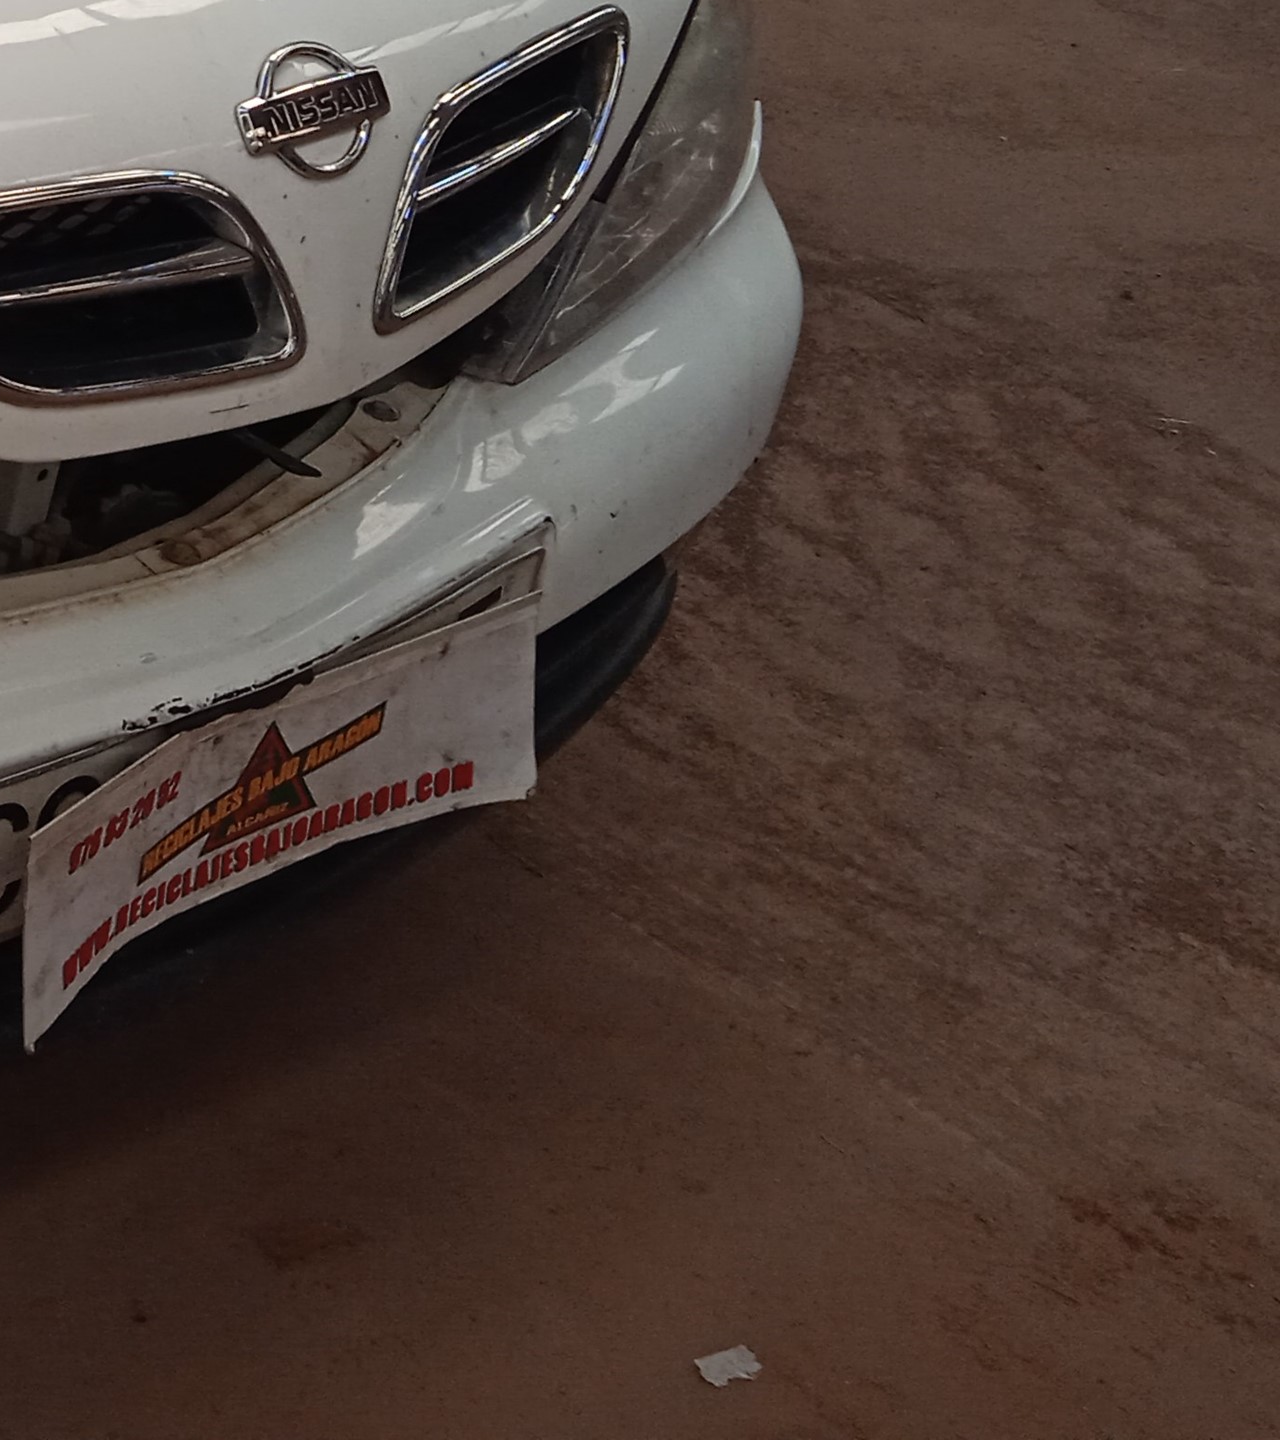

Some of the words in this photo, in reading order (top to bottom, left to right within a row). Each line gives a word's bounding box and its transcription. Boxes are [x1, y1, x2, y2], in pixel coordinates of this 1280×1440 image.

[262, 76, 380, 137] NISSAN
[246, 756, 301, 802] BAJO
[63, 759, 474, 990] WWW.RECICLAJESBAJOARAGON.COM
